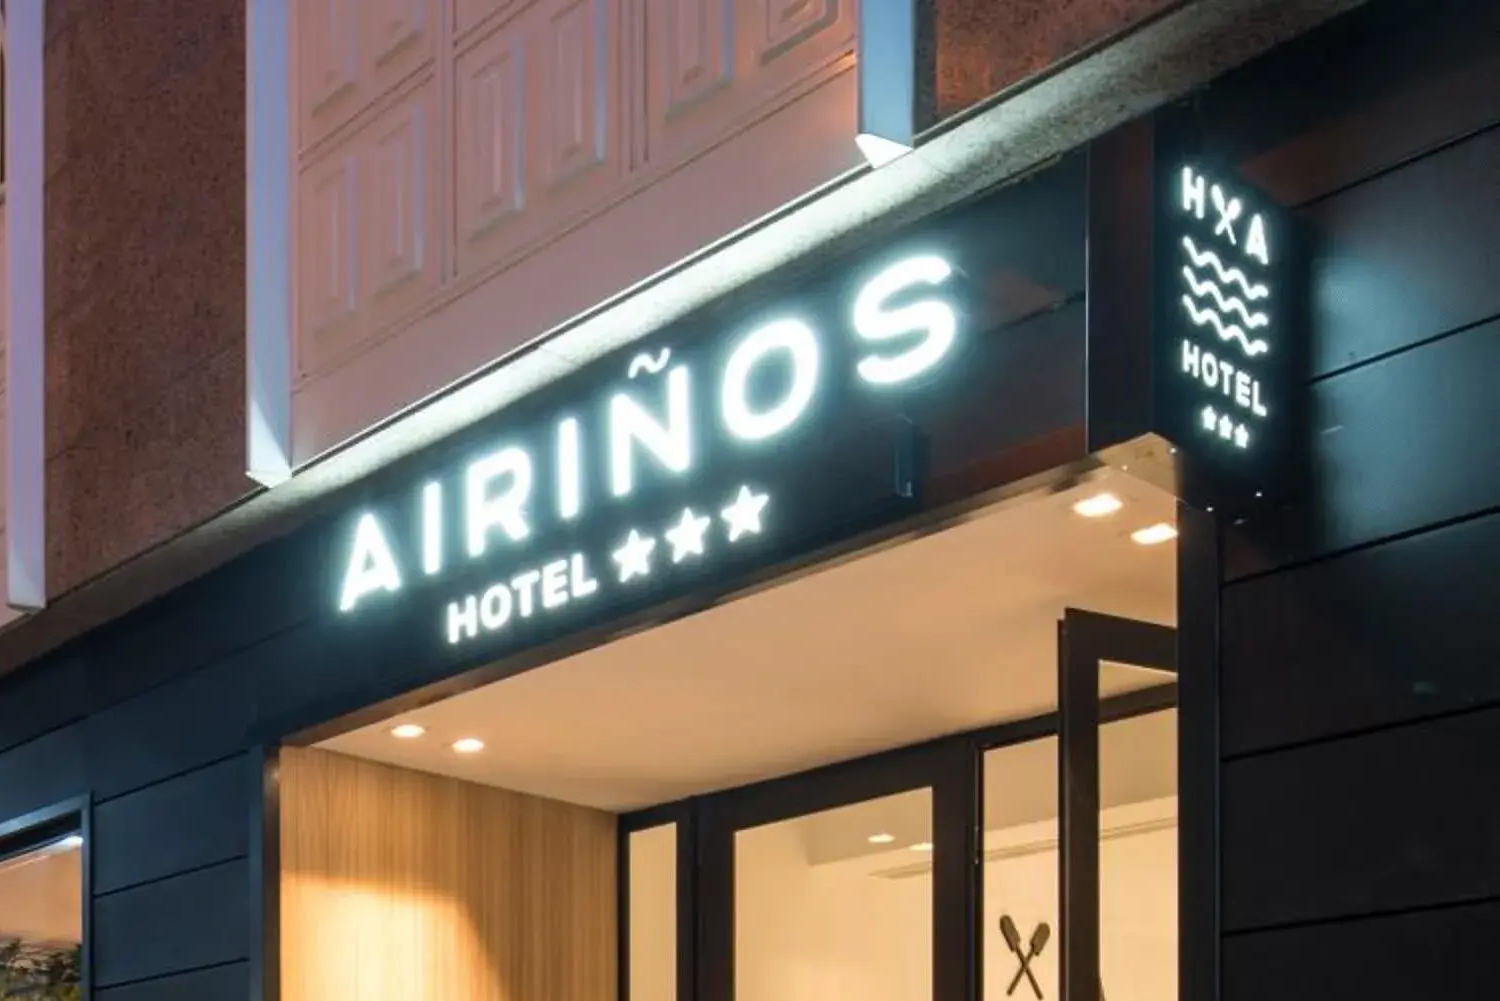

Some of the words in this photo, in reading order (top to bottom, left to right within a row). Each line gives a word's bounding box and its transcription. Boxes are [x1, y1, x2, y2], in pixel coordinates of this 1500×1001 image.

[1182, 338, 1268, 417] HOTEL
[340, 254, 958, 612] AIRIÑOS
[446, 553, 597, 644] HOTEL
